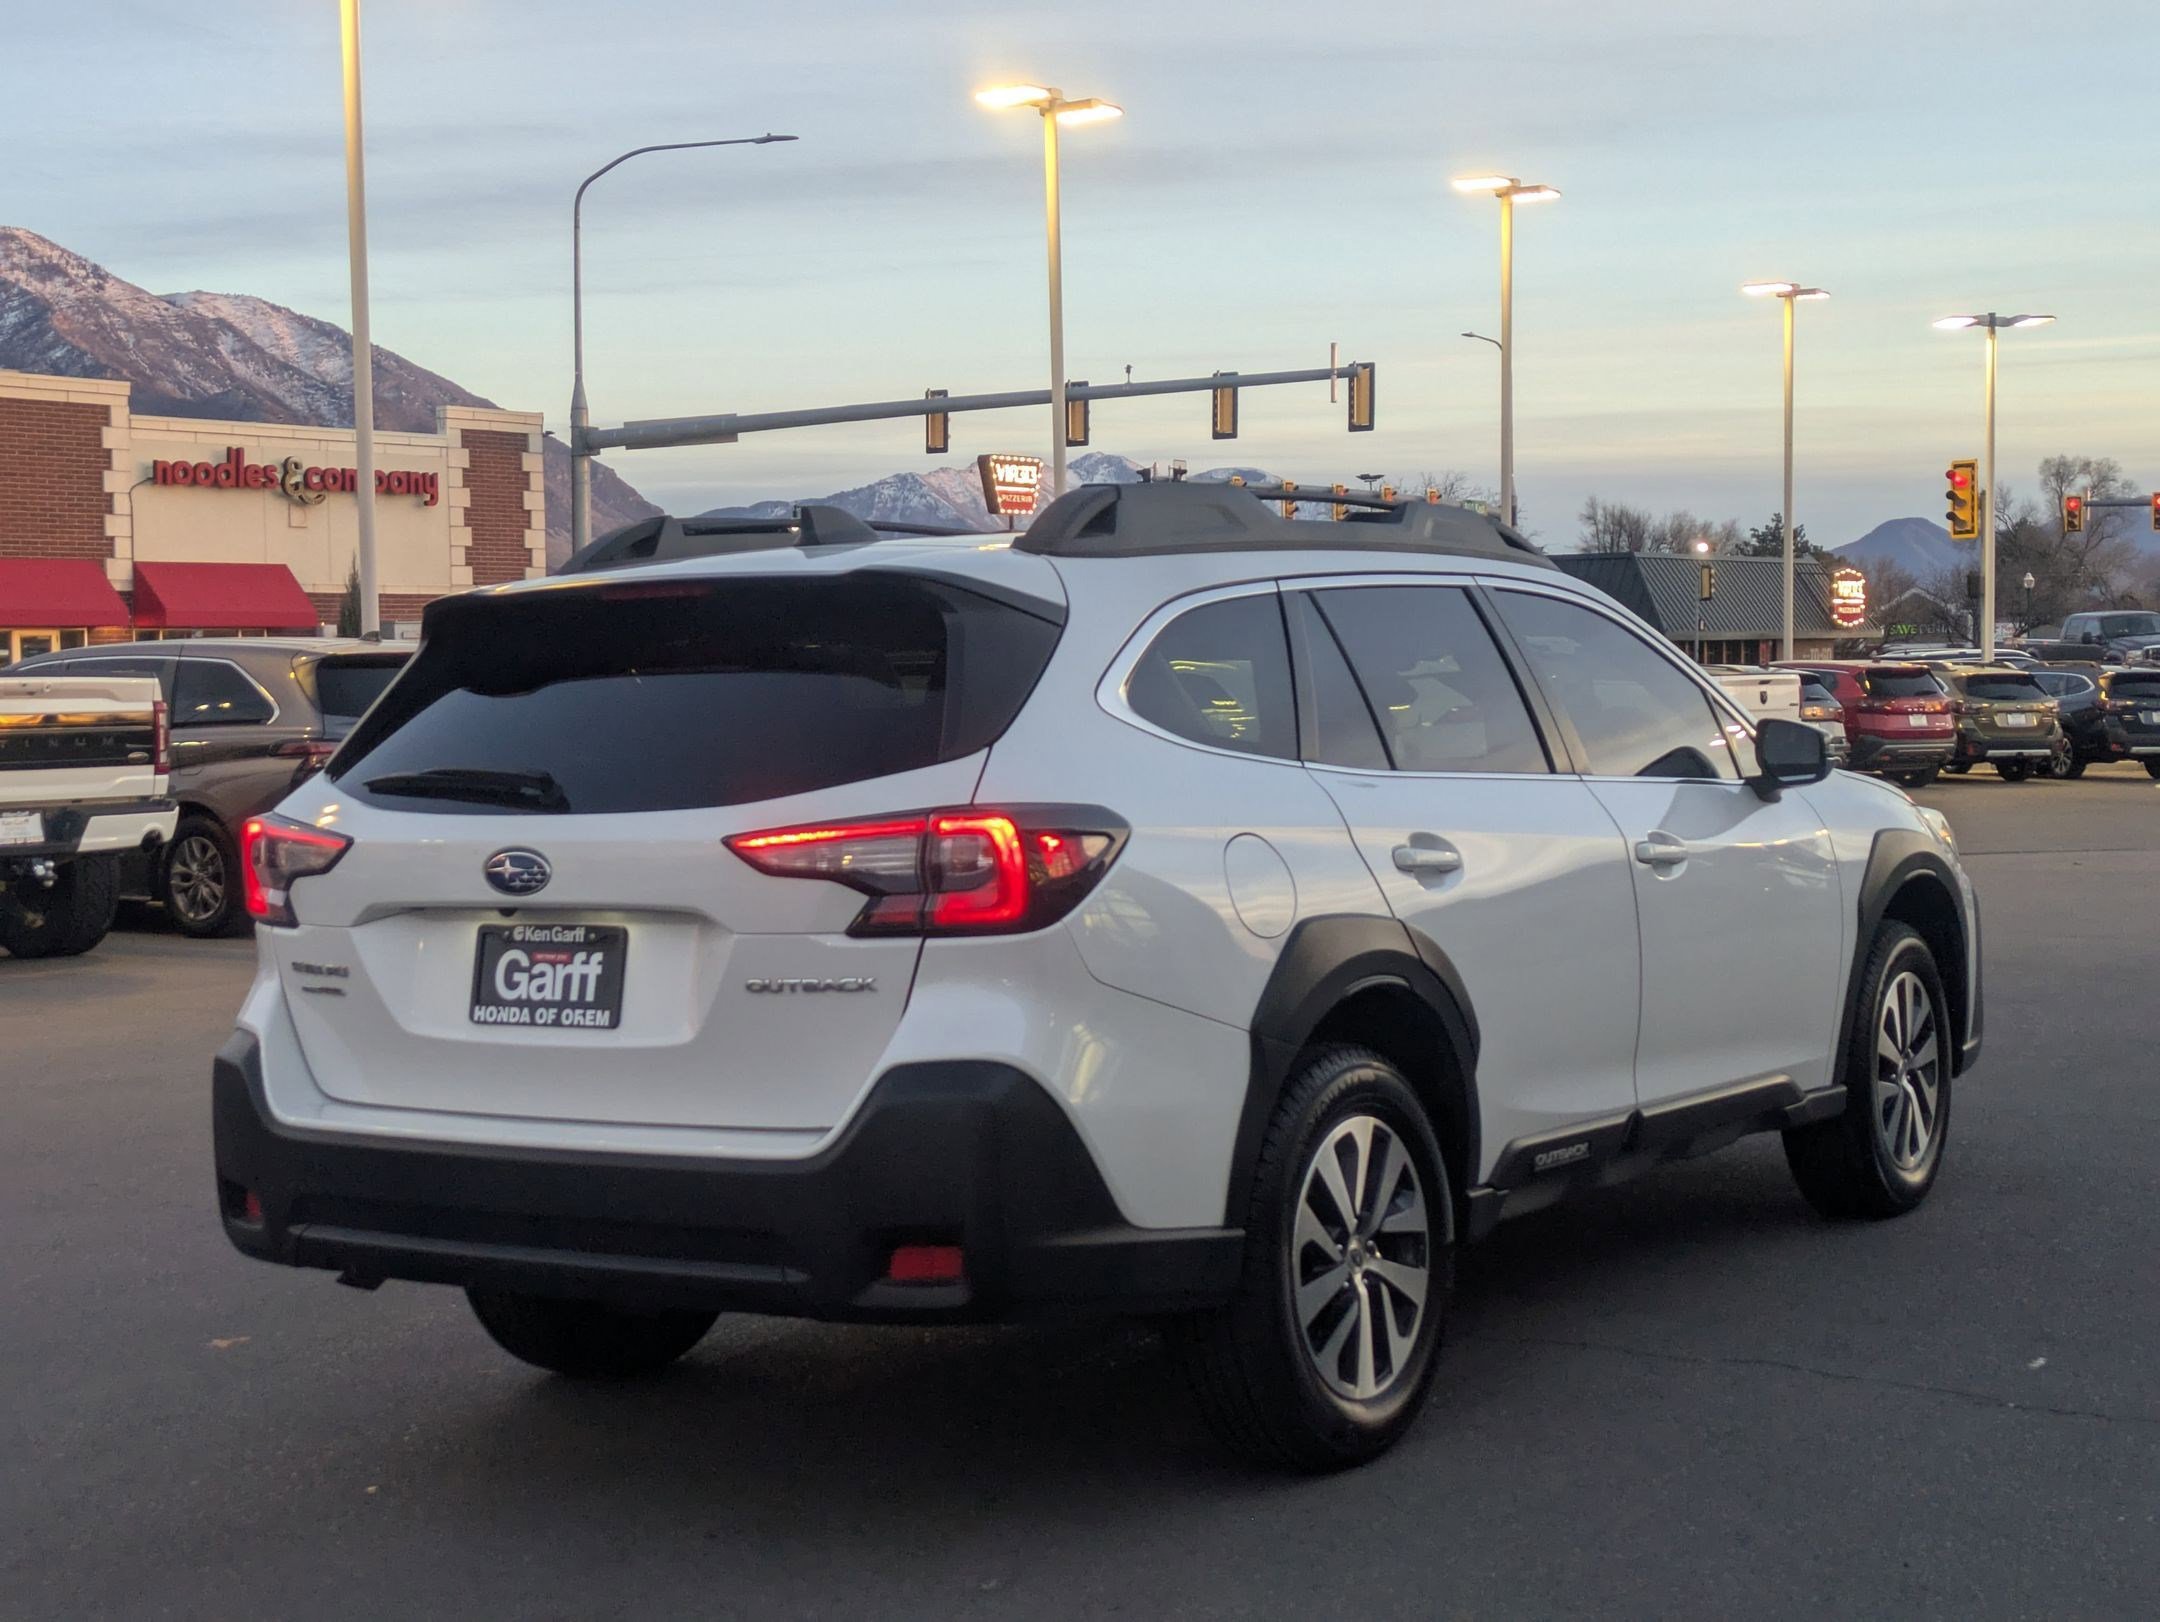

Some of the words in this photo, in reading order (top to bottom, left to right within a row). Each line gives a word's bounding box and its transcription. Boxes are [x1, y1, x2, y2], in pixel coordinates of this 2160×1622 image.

[153, 446, 278, 489] noodles
[280, 455, 326, 505] &
[1889, 624, 1917, 635] SAVE
[525, 926, 550, 942] Ken
[551, 926, 586, 943] Garff
[495, 949, 604, 1002] Garff
[473, 1005, 531, 1023] HONDA
[535, 1007, 557, 1024] OF
[561, 1008, 611, 1026] OREM
